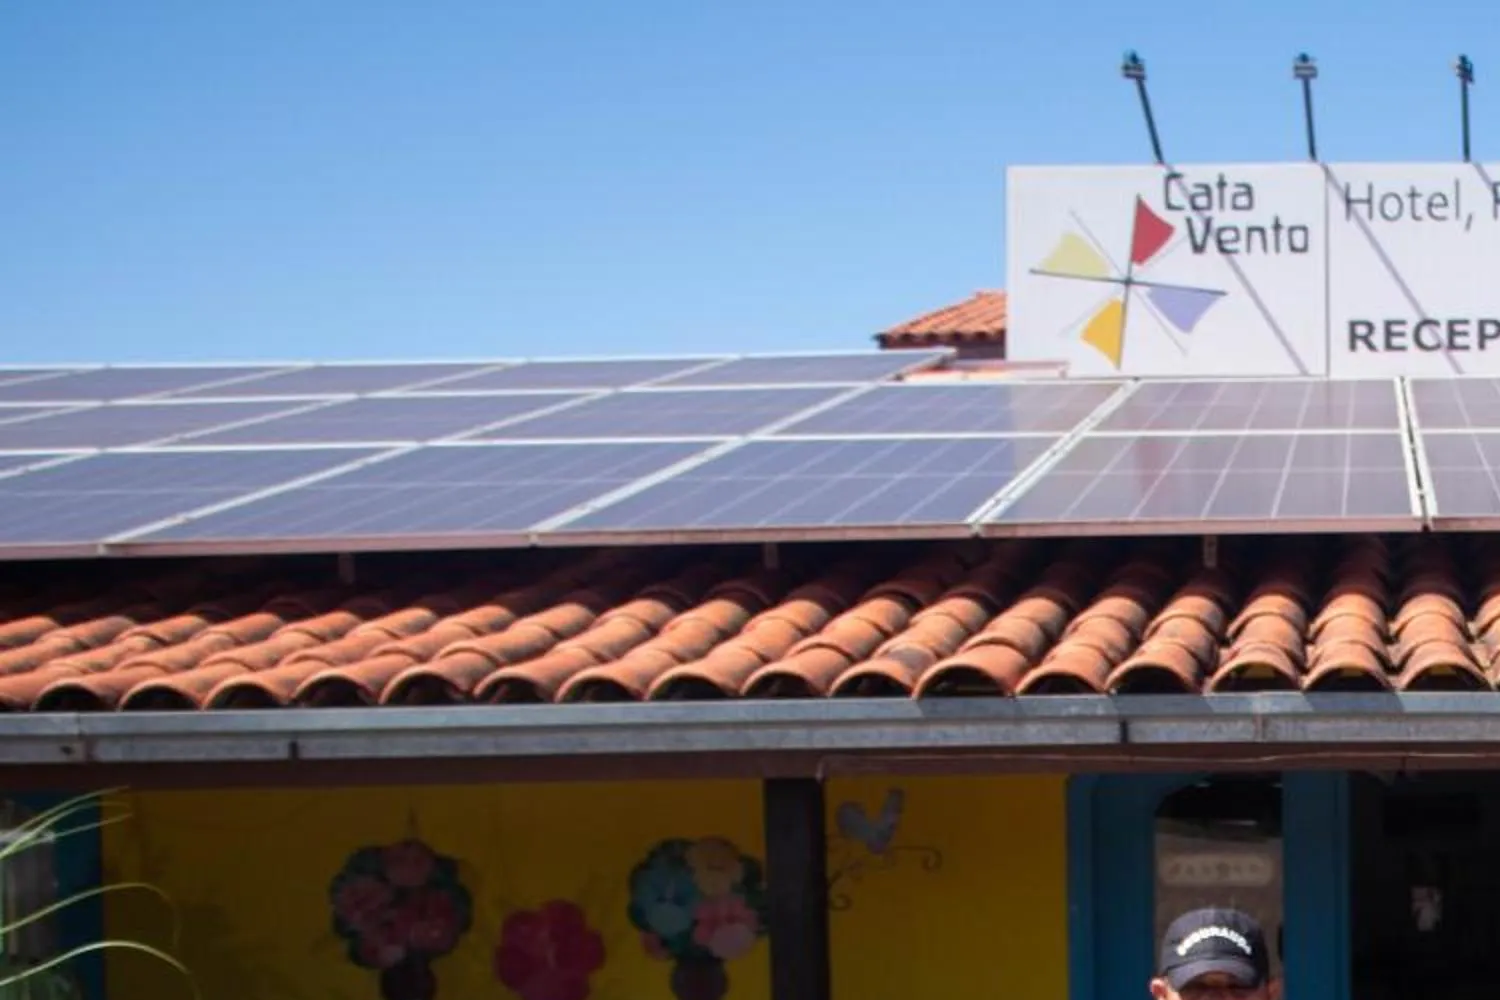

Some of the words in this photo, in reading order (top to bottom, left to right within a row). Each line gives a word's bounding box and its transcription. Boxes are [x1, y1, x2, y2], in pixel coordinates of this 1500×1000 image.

[1164, 172, 1255, 212] Cata
[1345, 177, 1473, 232] Hotel,
[1185, 214, 1309, 255] Vento
